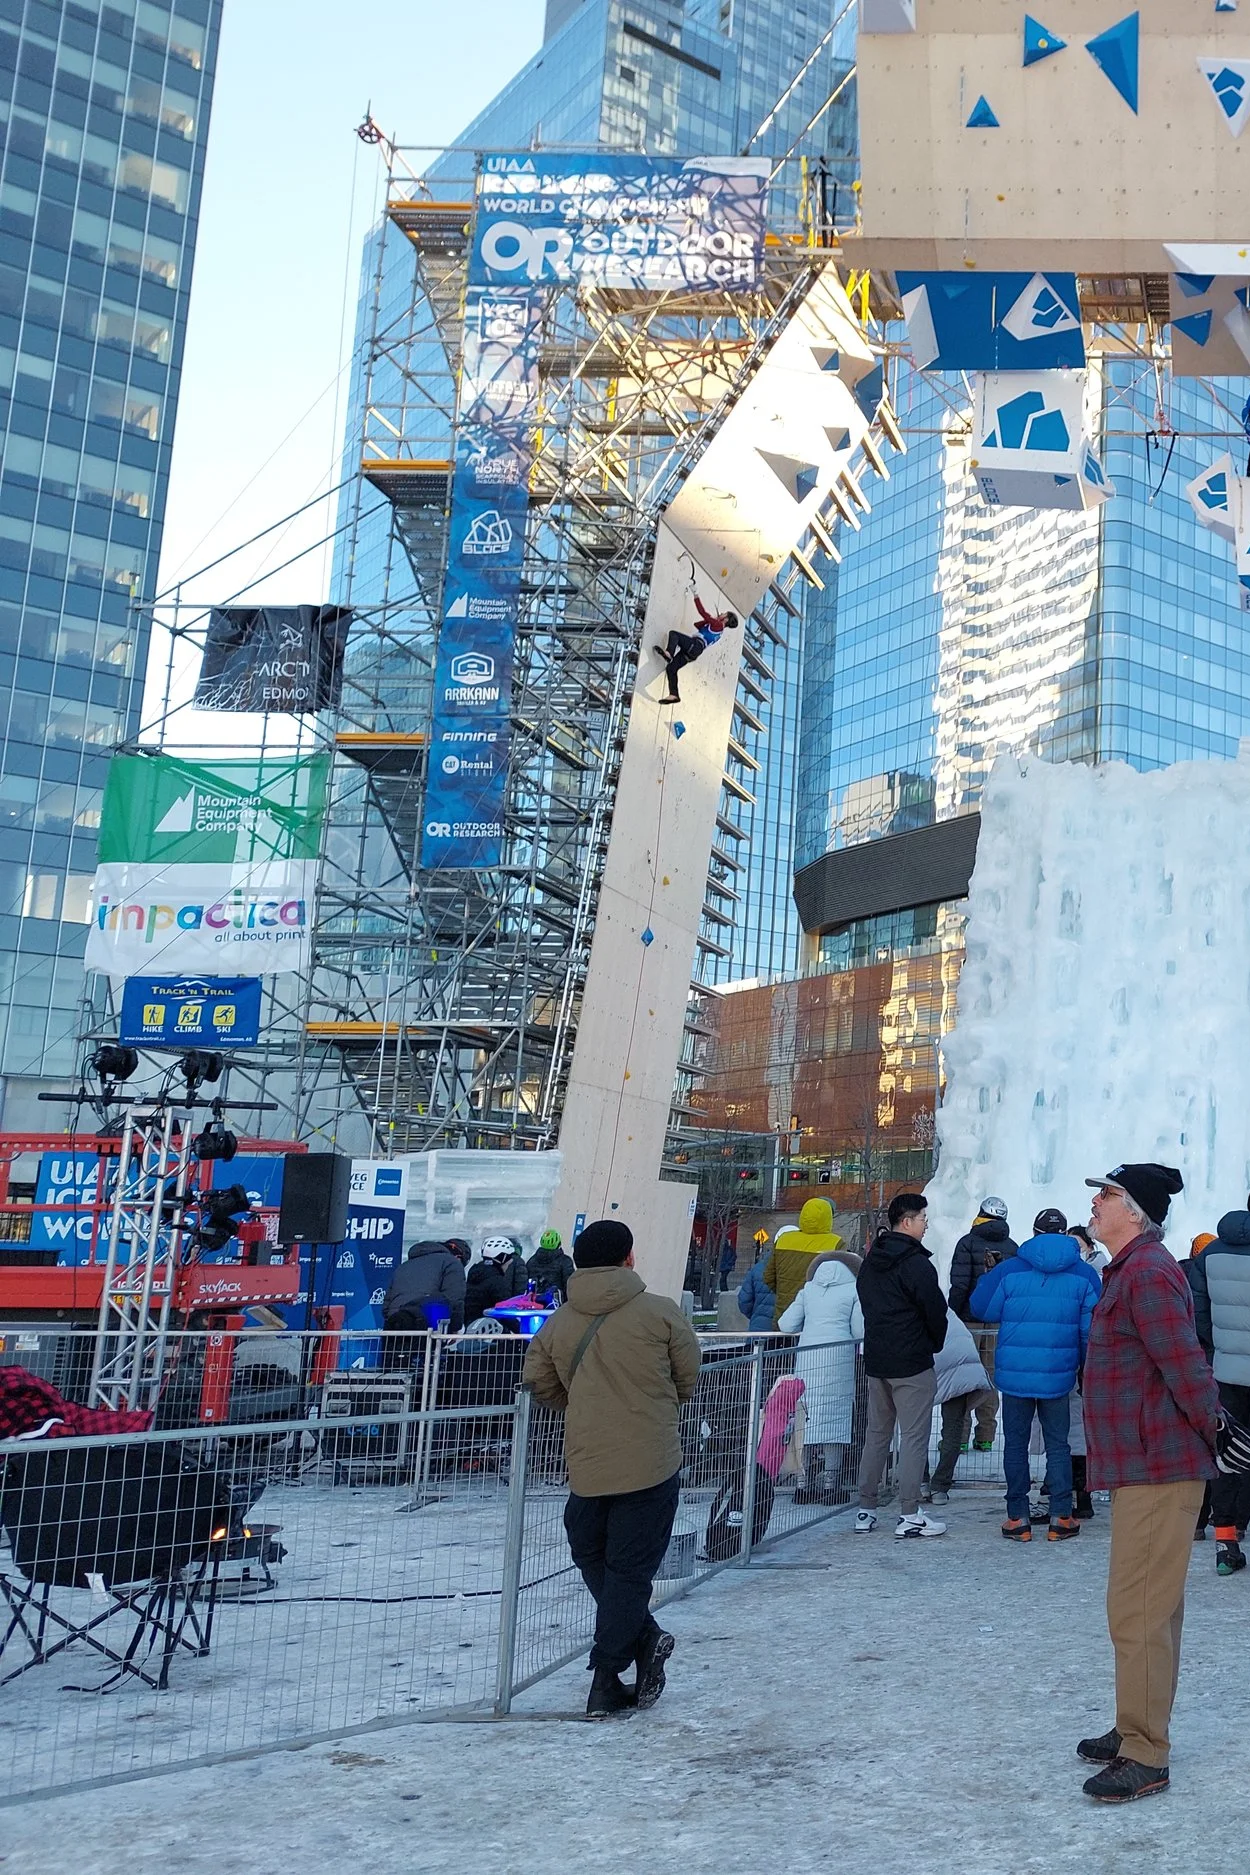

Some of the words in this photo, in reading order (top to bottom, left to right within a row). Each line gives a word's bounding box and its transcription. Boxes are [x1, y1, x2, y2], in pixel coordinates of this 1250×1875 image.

[487, 157, 535, 172] UIAA
[484, 198, 555, 213] WORLD
[481, 221, 574, 281] OR
[581, 231, 754, 258] OUTDOOR
[574, 255, 755, 283] RESEARCH
[475, 466, 519, 474] NORTH
[463, 544, 509, 554] BLOCS
[469, 598, 507, 606] Mountain
[469, 605, 511, 613] Equipment
[468, 612, 506, 620] Company
[445, 687, 499, 700] ARRKANN
[442, 732, 497, 742] FINNING
[460, 760, 493, 769] Rental
[198, 795, 261, 807] Mountain
[197, 807, 272, 820] Equipment
[195, 820, 262, 834] Company
[426, 822, 451, 837] OR
[453, 822, 500, 830] OUTDOOR
[99, 890, 306, 943] impactica
[214, 931, 230, 942] all
[234, 930, 271, 941] about
[275, 930, 306, 944] print
[151, 986, 186, 995] TRACK
[202, 987, 234, 995] TRAIL
[350, 1182, 365, 1190] CE
[199, 1279, 241, 1294] SKYJACK
